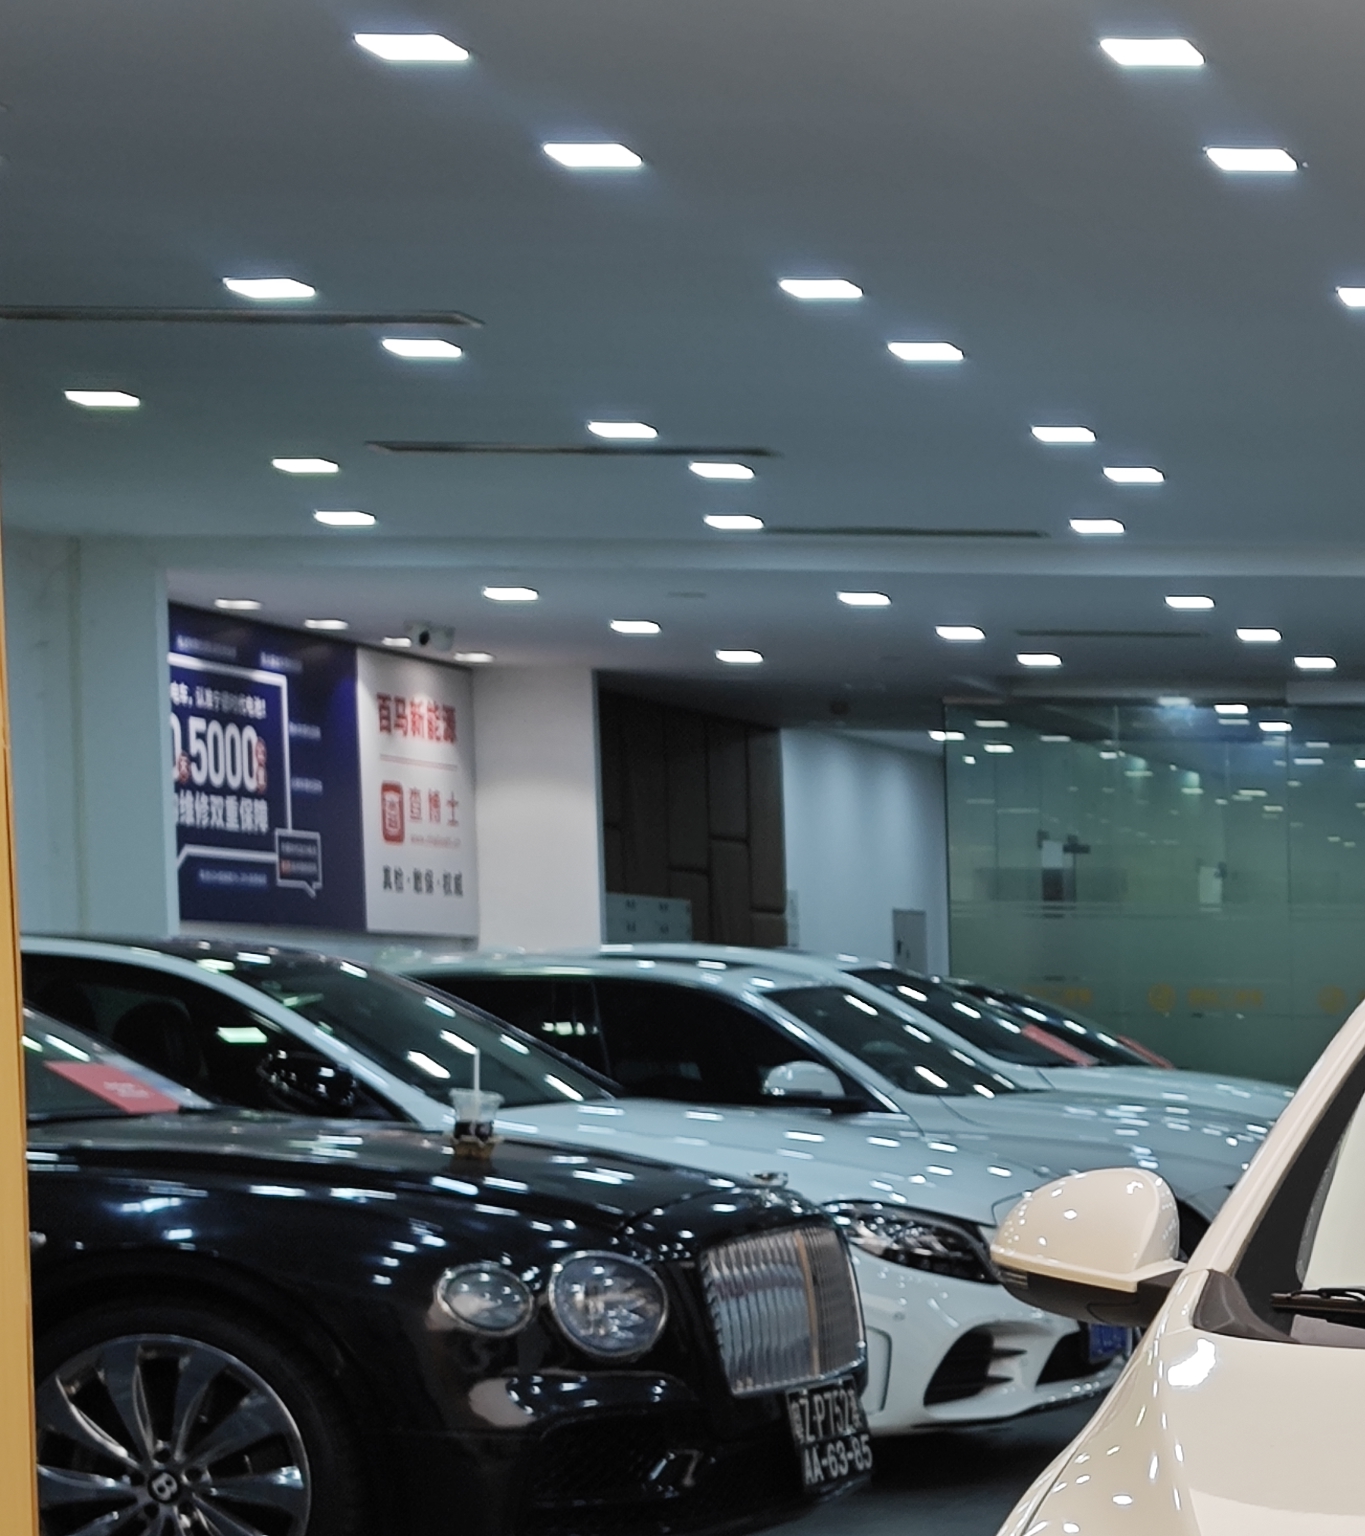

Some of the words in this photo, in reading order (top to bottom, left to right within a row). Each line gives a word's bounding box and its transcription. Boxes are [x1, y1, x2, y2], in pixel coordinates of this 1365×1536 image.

[376, 692, 457, 743] 百马新能源
[174, 789, 268, 834] 维修双重保障
[804, 1434, 873, 1484] AA-63-85
